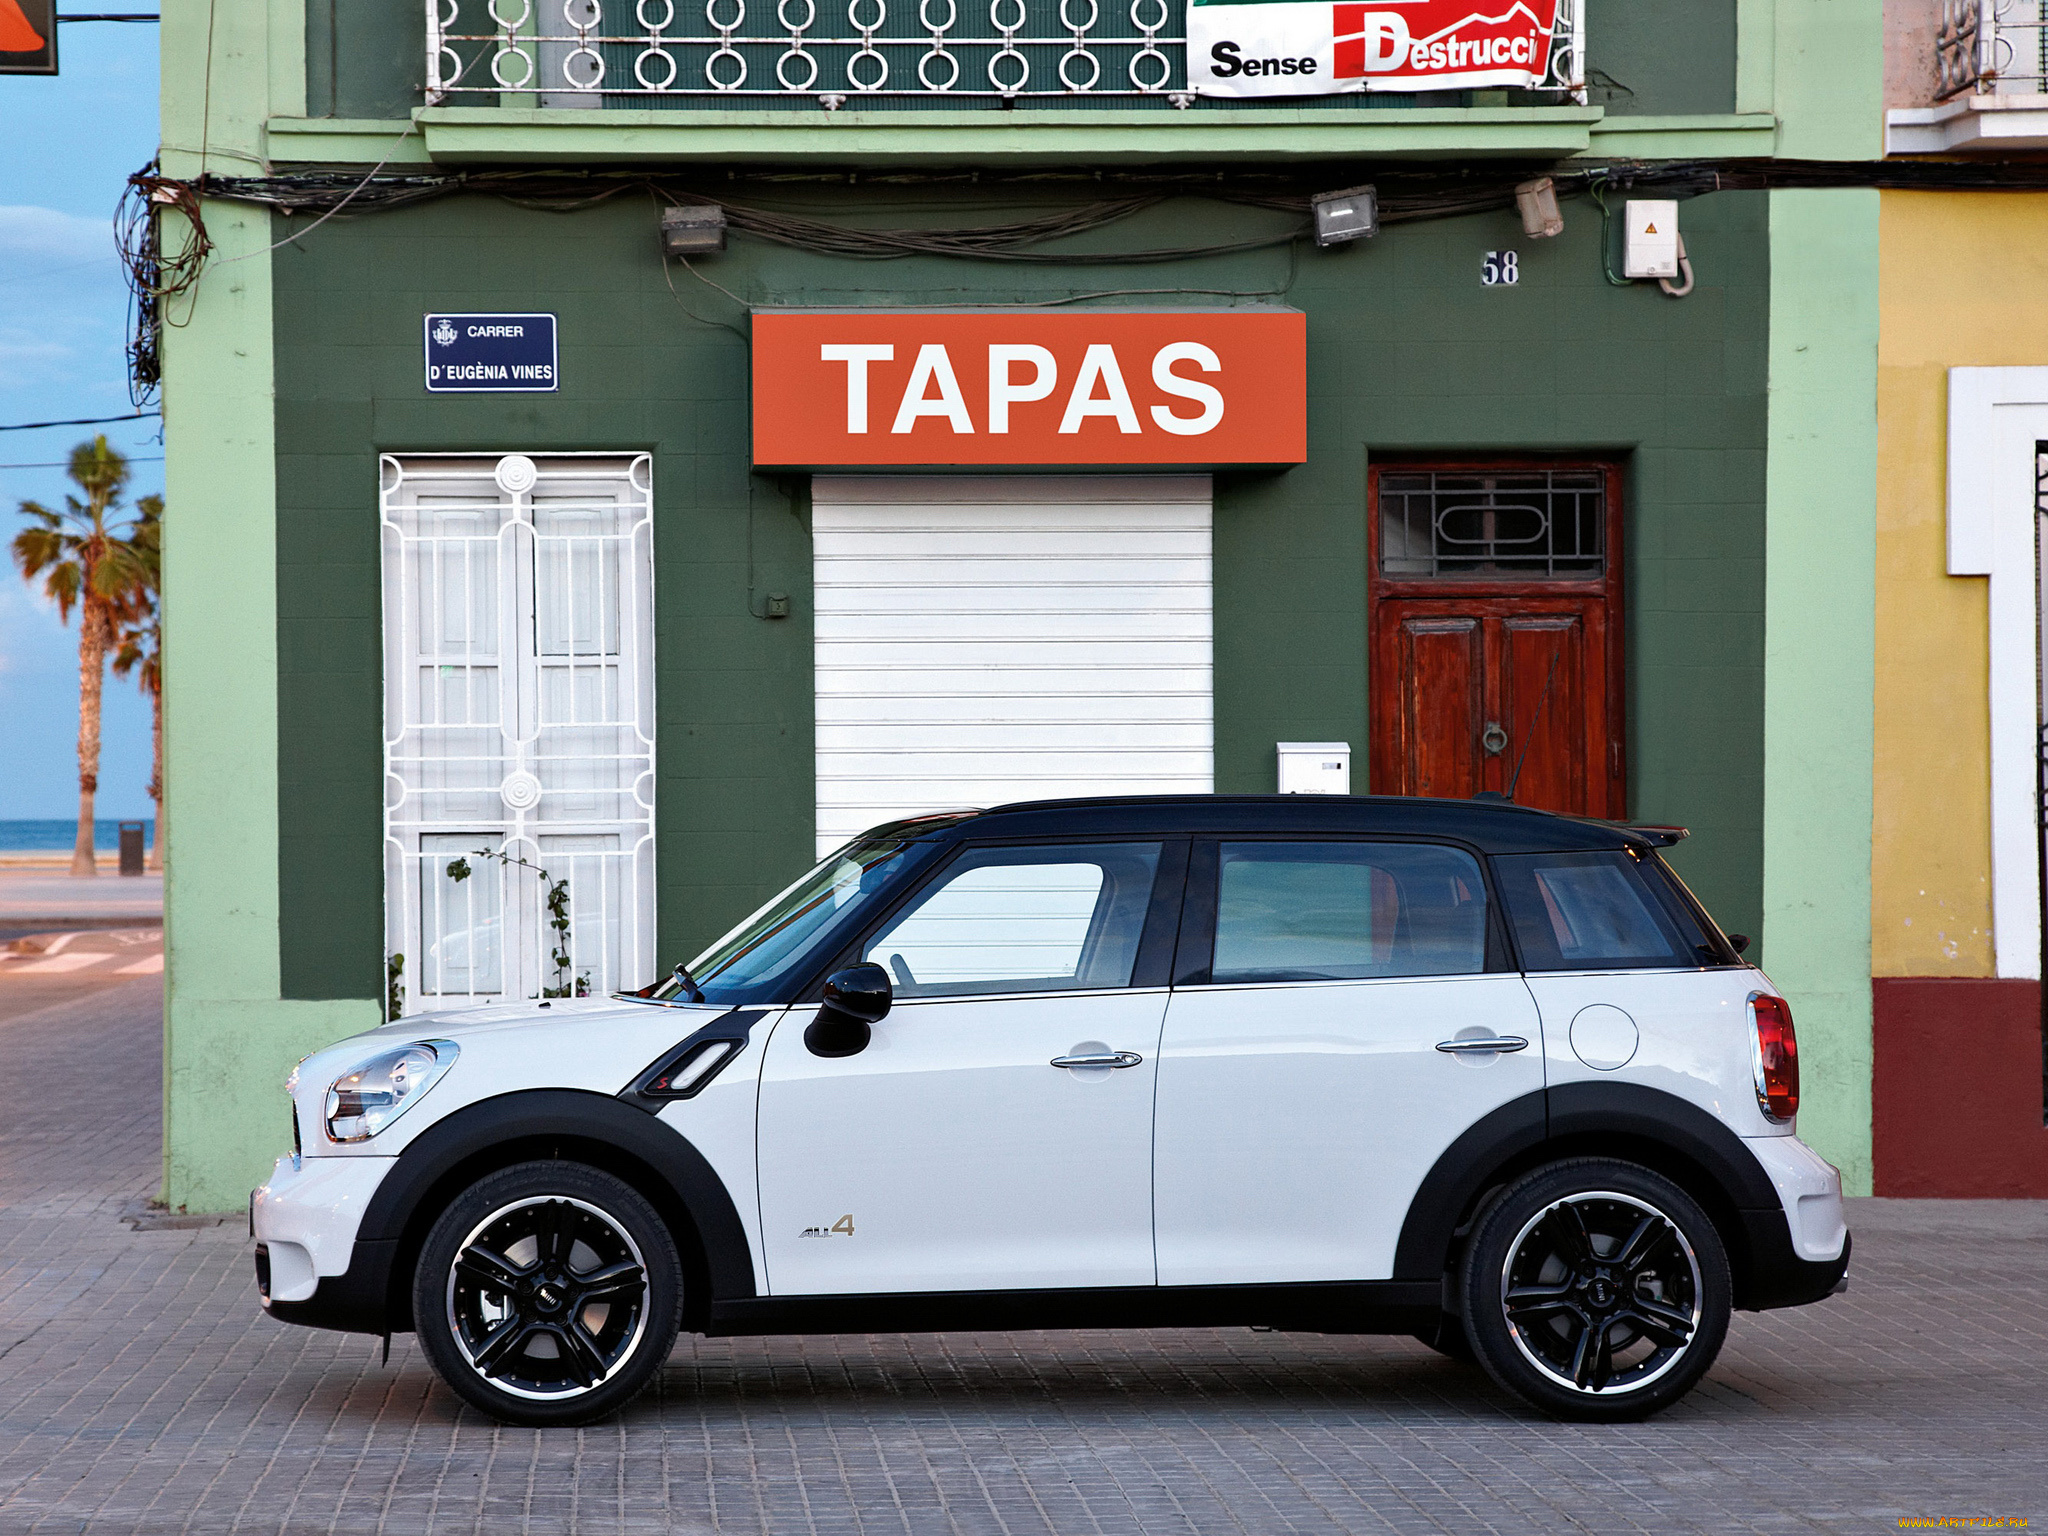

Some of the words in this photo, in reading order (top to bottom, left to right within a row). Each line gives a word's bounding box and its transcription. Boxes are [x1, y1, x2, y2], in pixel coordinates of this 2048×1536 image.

[1210, 41, 1318, 77] Sense
[1363, 11, 1538, 72] Destrucci
[1481, 250, 1519, 285] 58
[467, 325, 524, 338] CARRER
[511, 365, 553, 380] VINES
[820, 341, 1225, 436] TAPAS
[657, 1077, 669, 1089] S
